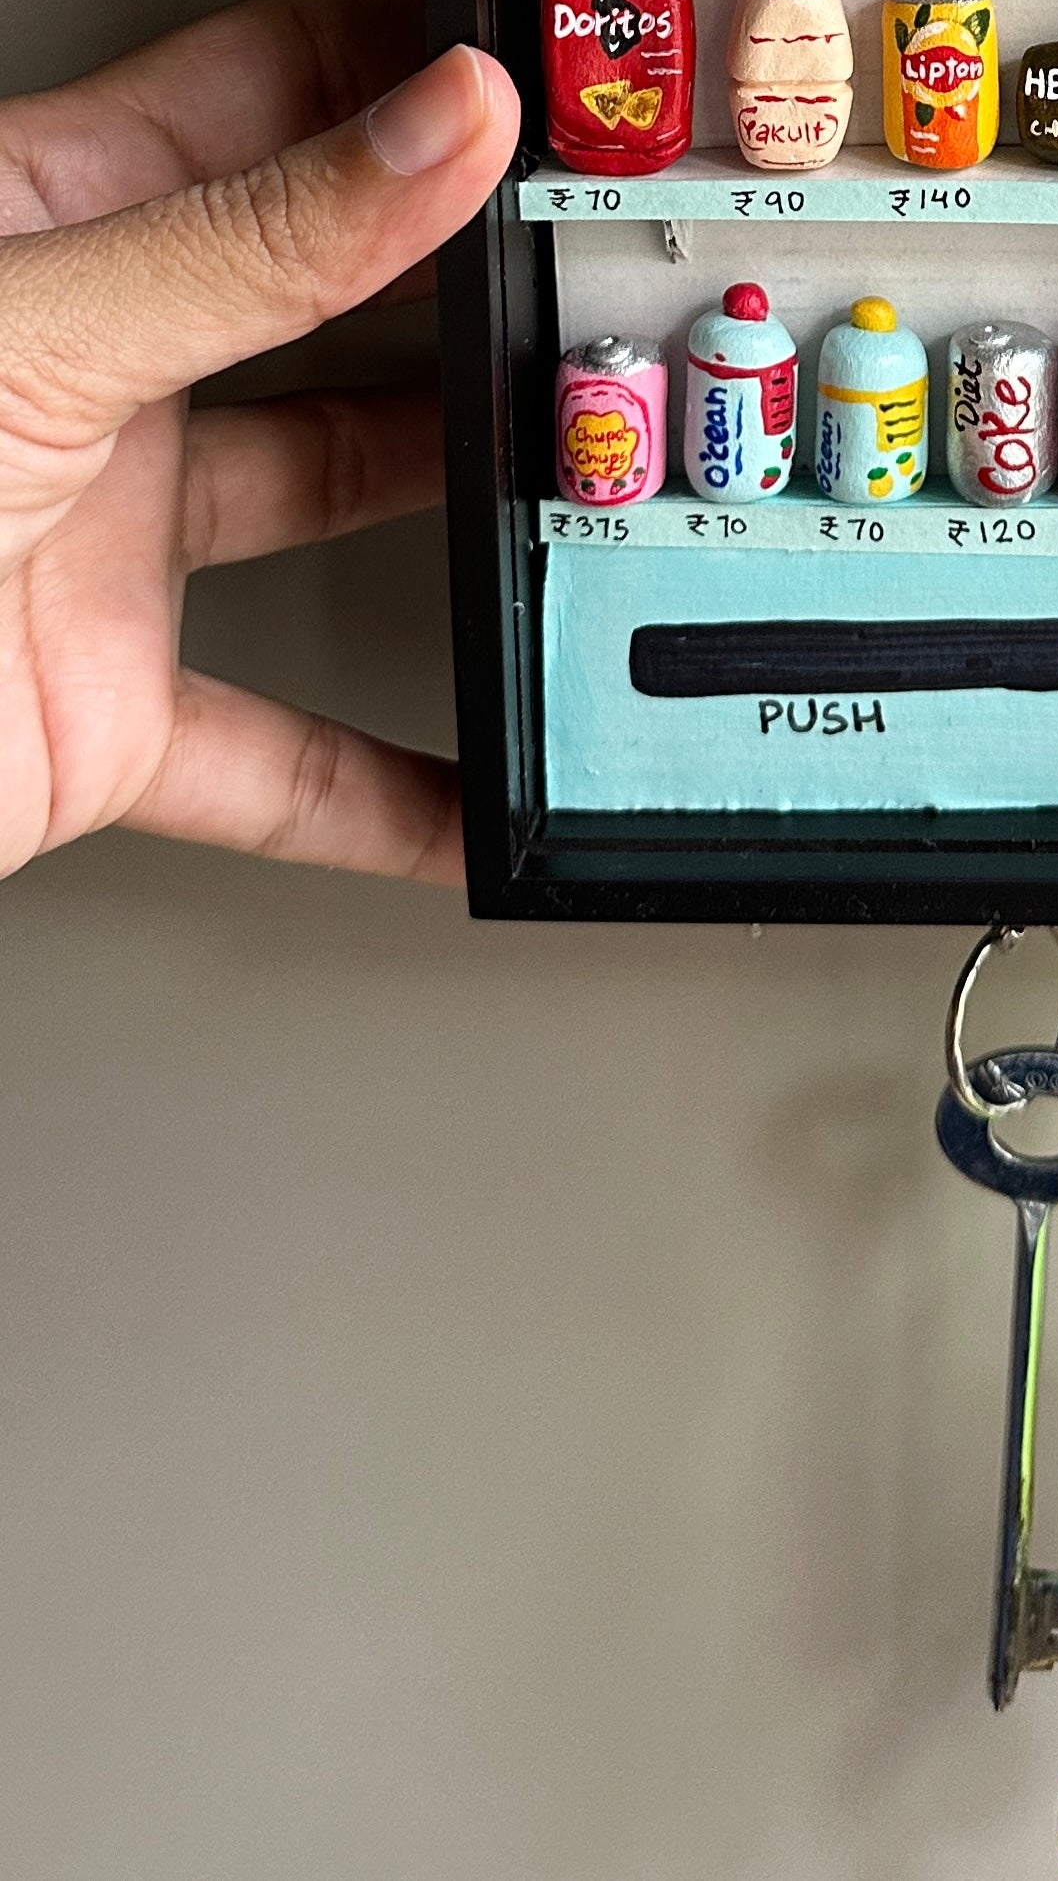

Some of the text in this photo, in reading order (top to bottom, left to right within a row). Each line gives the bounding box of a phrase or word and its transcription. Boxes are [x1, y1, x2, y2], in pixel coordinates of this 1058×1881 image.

[553, 3, 672, 40] Doritos
[905, 53, 983, 89] Lipton
[743, 119, 826, 147] Yakult
[953, 354, 982, 432] Diet
[575, 426, 627, 446] Chupa
[574, 450, 628, 472] Chups
[759, 699, 886, 735] PUSH
